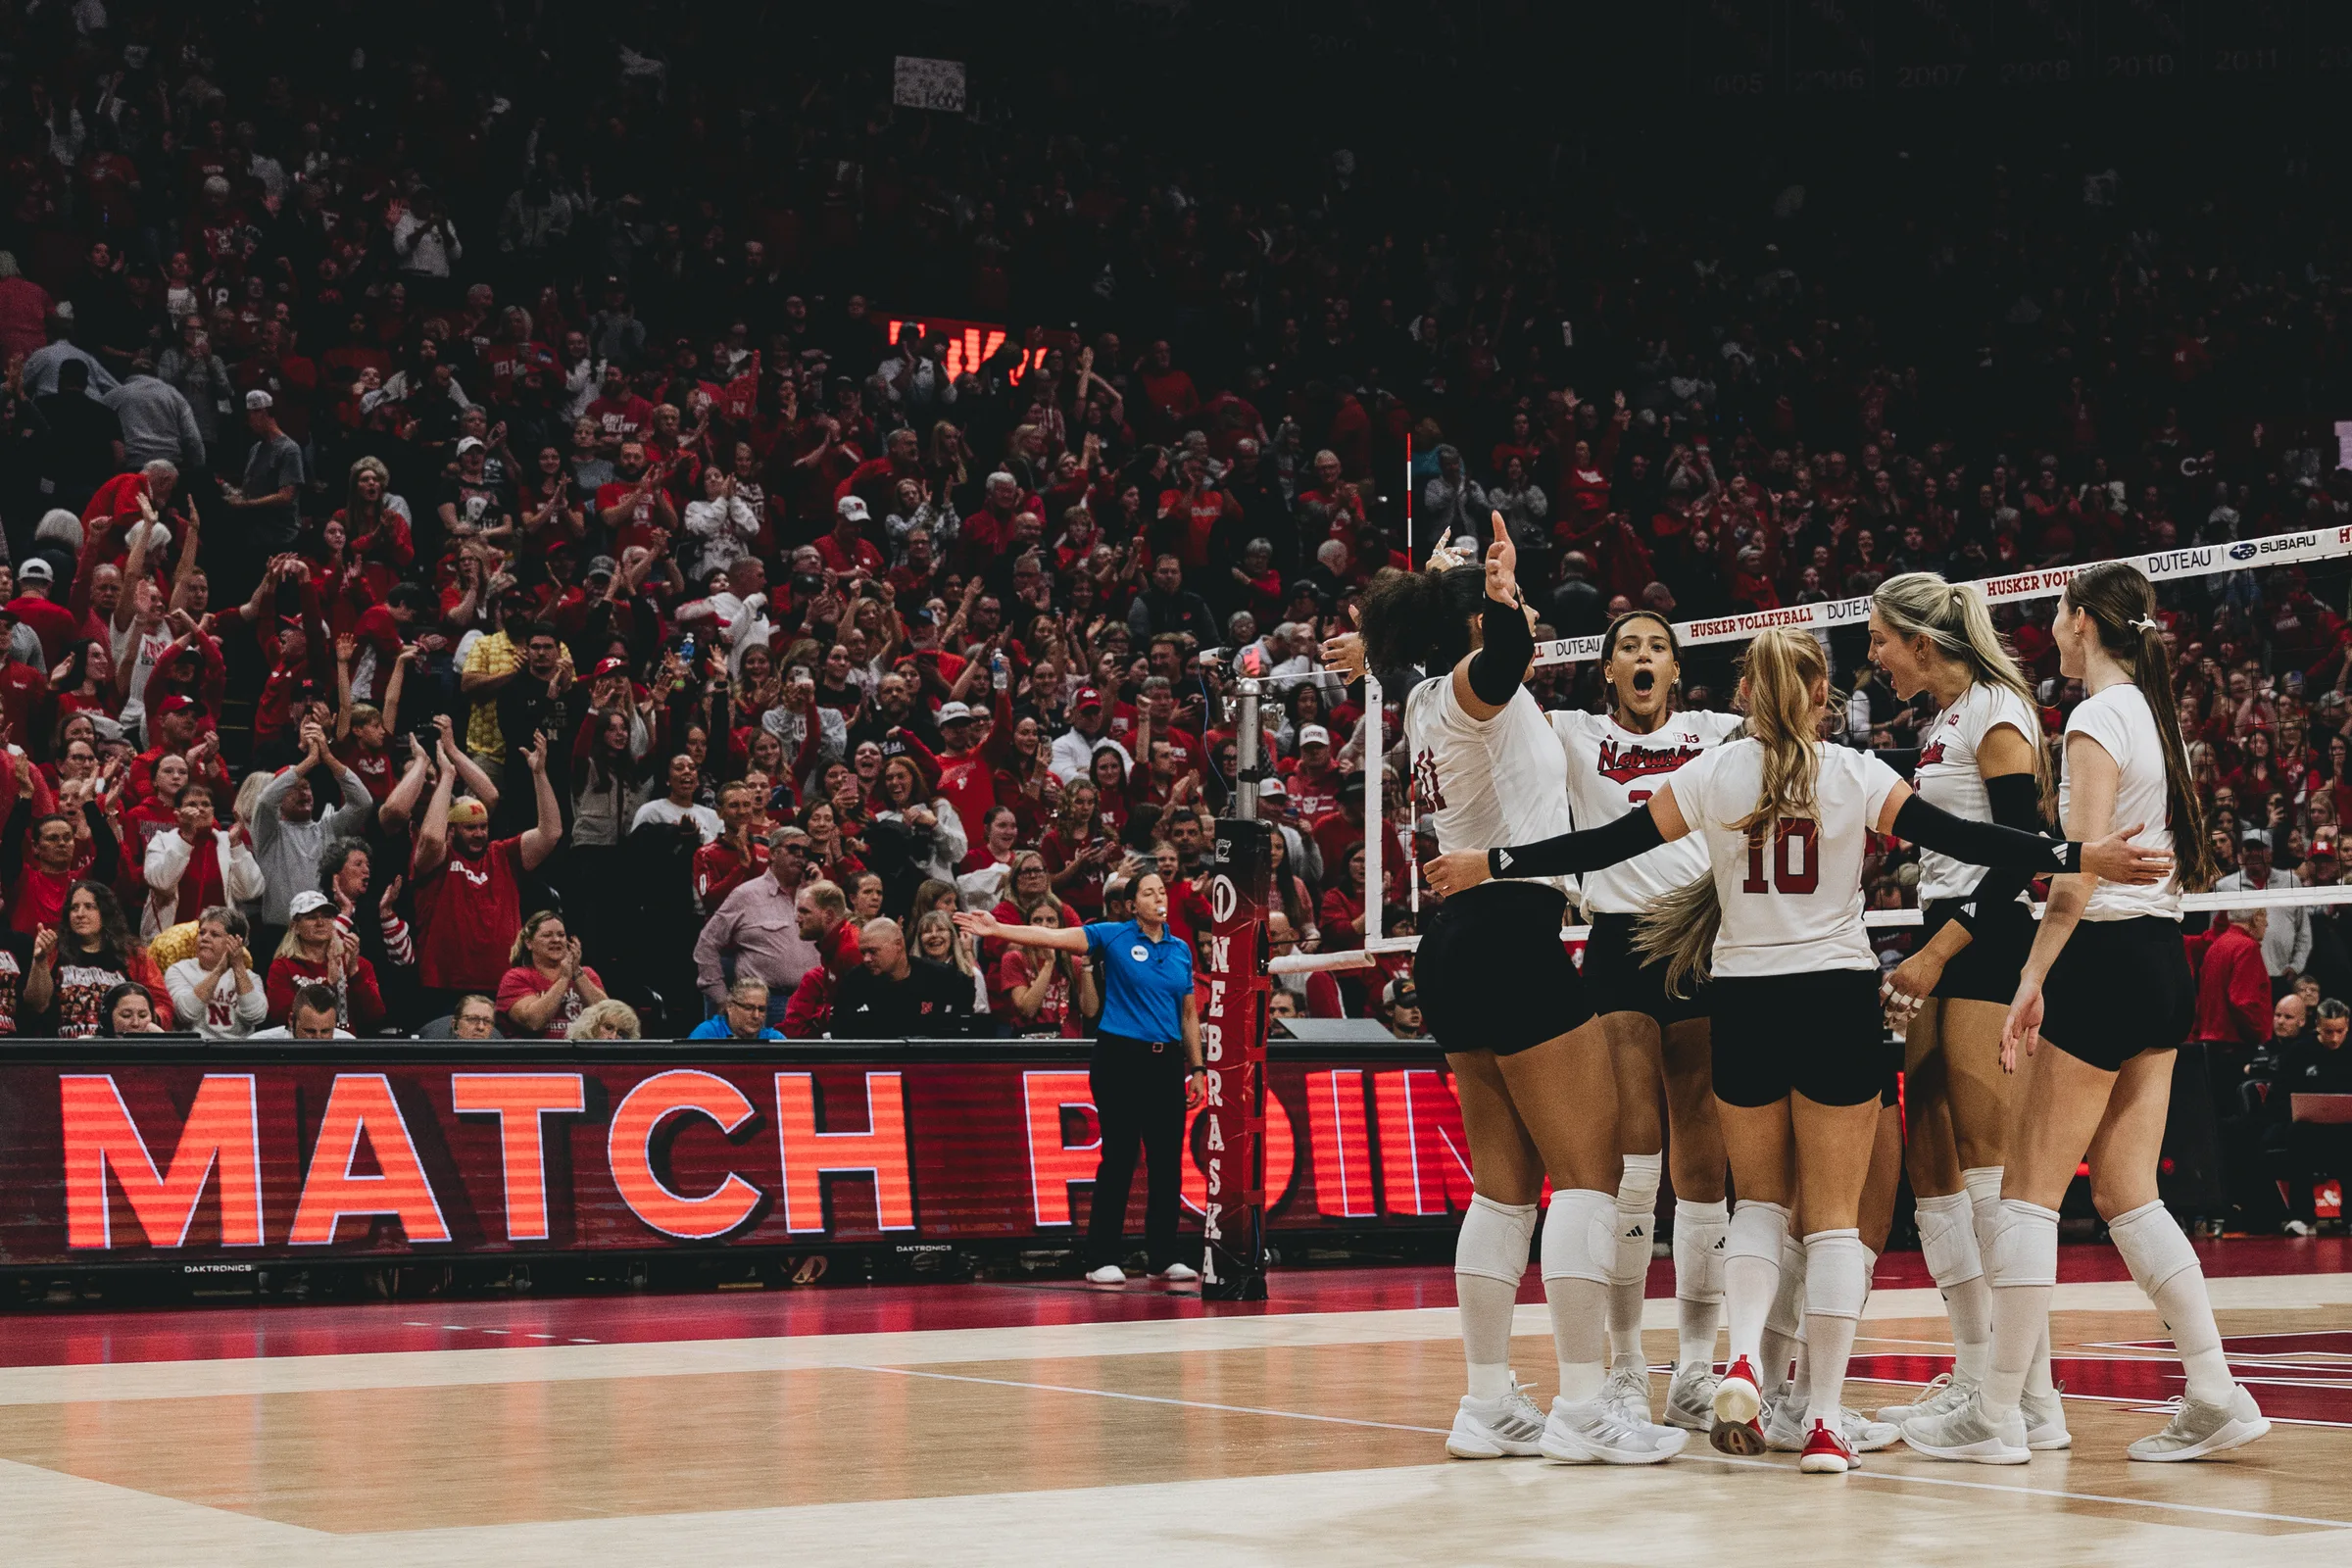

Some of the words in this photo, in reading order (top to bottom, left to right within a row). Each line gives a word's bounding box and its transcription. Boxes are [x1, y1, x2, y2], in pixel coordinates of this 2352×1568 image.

[1895, 63, 1968, 88] 2007
[602, 412, 625, 424] GRIT
[2148, 549, 2212, 573] DUTEAU
[2260, 534, 2317, 554] SUBARU
[1987, 574, 2040, 597] HUSKER
[1827, 598, 1873, 619] DUTEA
[1690, 620, 1737, 638] HUSKER
[1739, 608, 1813, 631] VOLLEYBALL
[1556, 638, 1600, 657] DUTEAU
[1742, 817, 1820, 895] 10
[207, 1004, 233, 1027] N
[1202, 936, 1231, 1285] NEBRASKA
[59, 1069, 916, 1250] MATCH
[1022, 1069, 1556, 1228] POIN
[896, 1244, 953, 1253] DAKTRONICS
[184, 1263, 254, 1274] DAKTRONICS
